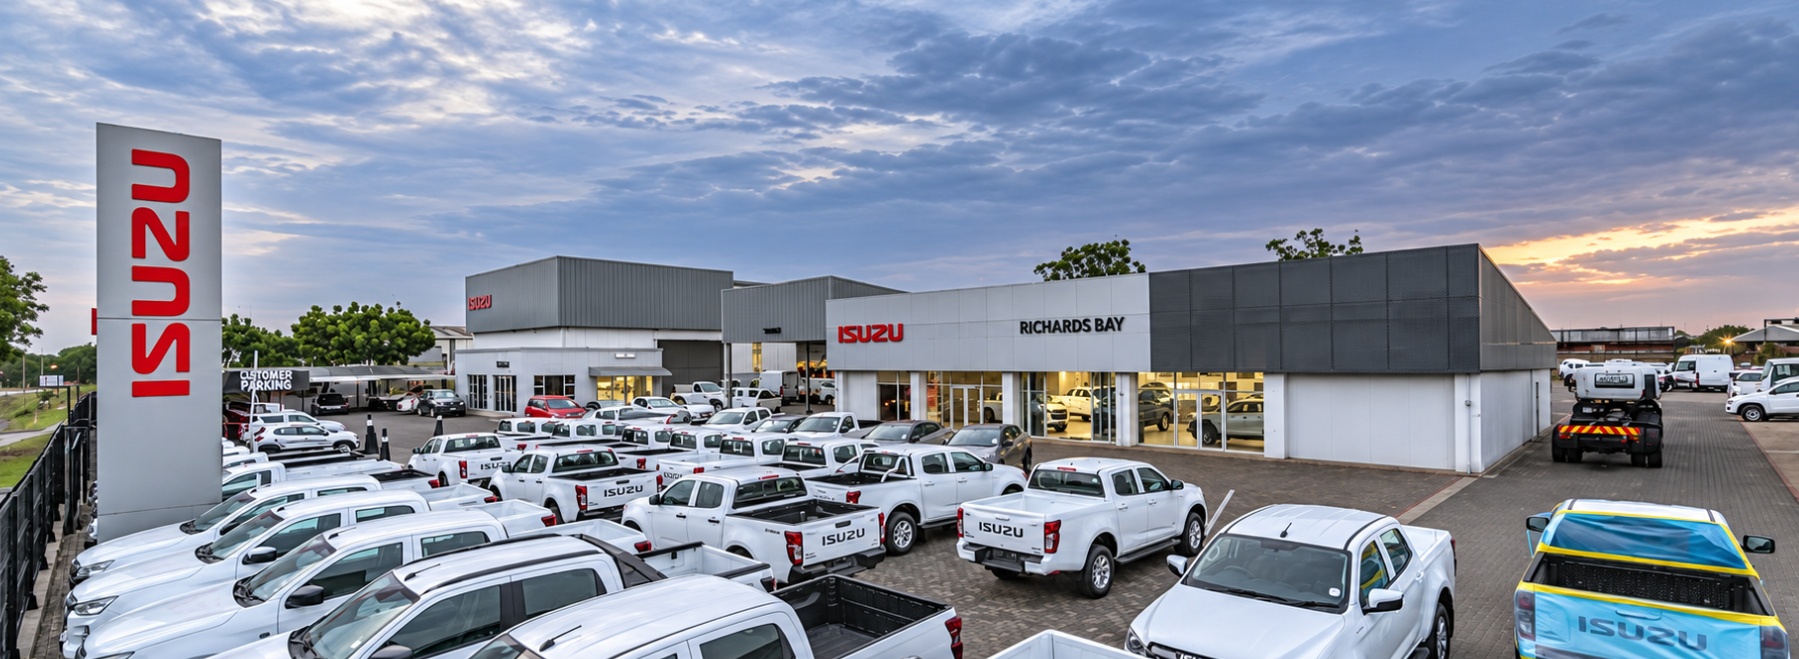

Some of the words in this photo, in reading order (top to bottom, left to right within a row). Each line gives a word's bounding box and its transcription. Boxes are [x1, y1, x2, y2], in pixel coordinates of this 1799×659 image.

[131, 148, 191, 398] ISUZU
[468, 294, 492, 311] ISUZU
[838, 323, 904, 344] ISUZU
[1019, 319, 1092, 335] RICHARDS
[1094, 317, 1125, 332] BAY
[240, 370, 293, 380] CUSTOMER
[240, 380, 292, 392] PARKING
[604, 485, 643, 497] ISUZU
[822, 528, 865, 546] ISUZU
[979, 522, 1023, 538] ISUZU
[1578, 615, 1707, 651] ISUZU
